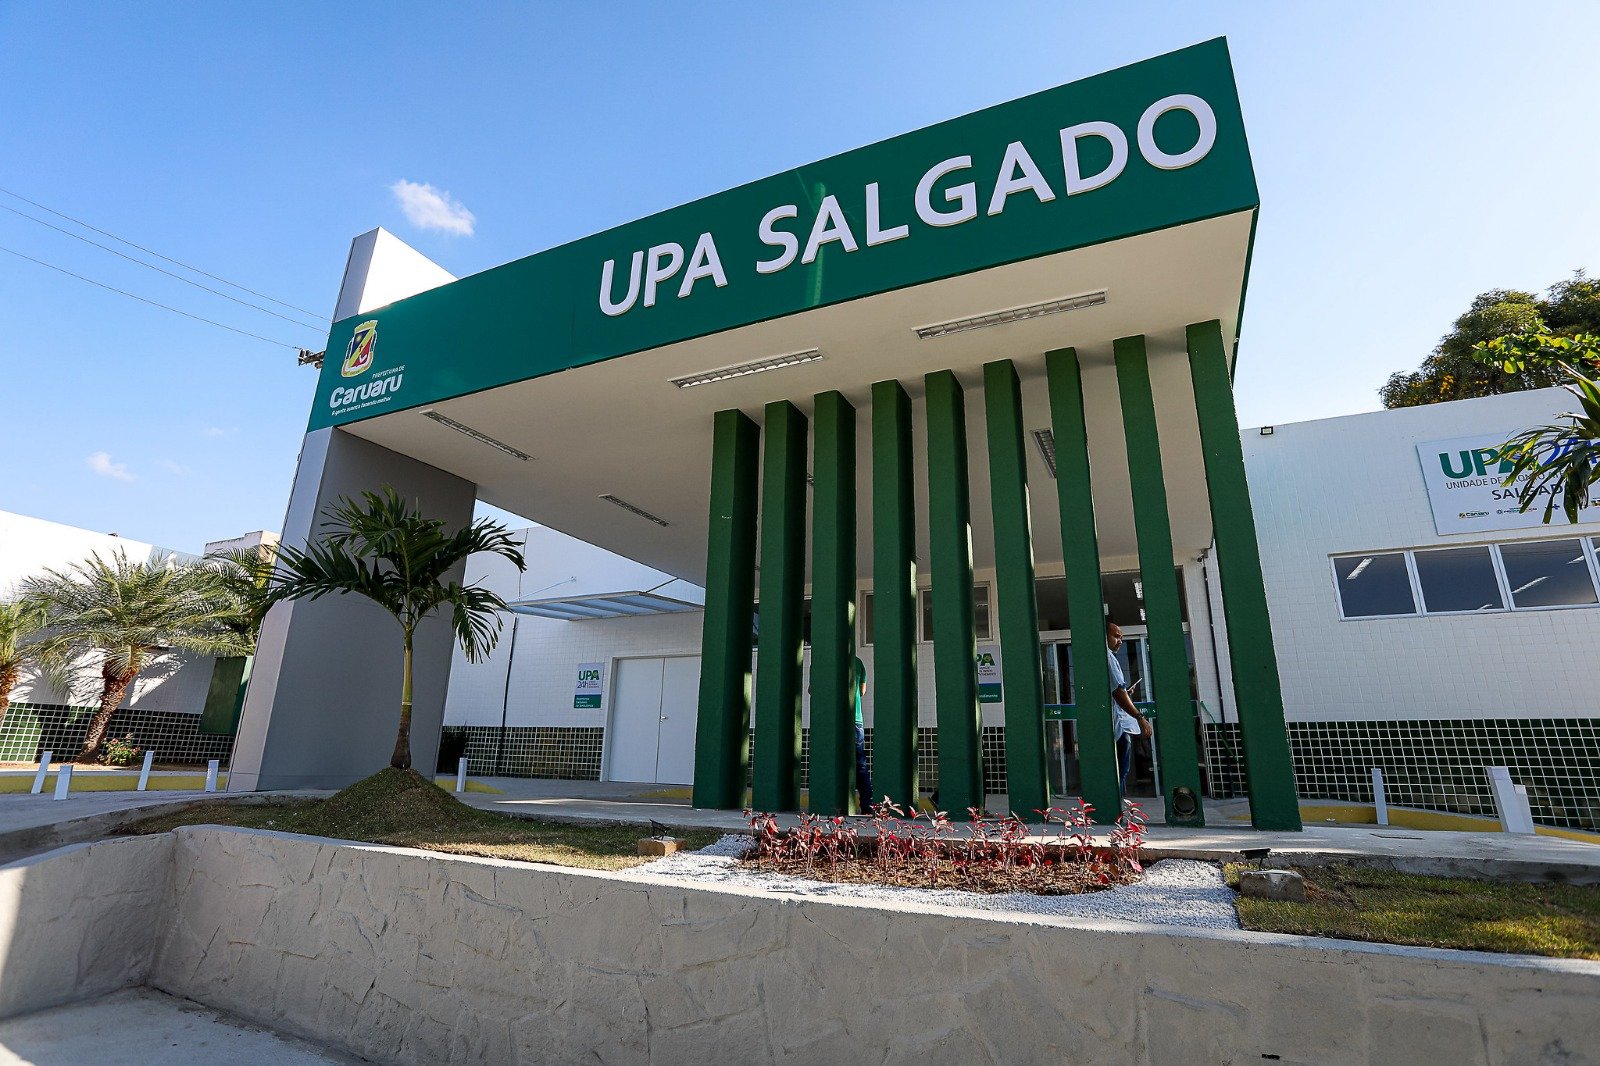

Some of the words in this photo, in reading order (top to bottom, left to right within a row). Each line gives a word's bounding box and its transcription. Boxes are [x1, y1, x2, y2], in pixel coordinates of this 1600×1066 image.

[599, 231, 728, 317] UPA
[756, 93, 1218, 274] SALGADO
[330, 374, 402, 408] Caruaru
[1446, 478, 1488, 490] UNIDADE
[1490, 475, 1502, 486] DE
[579, 670, 599, 680] UPA
